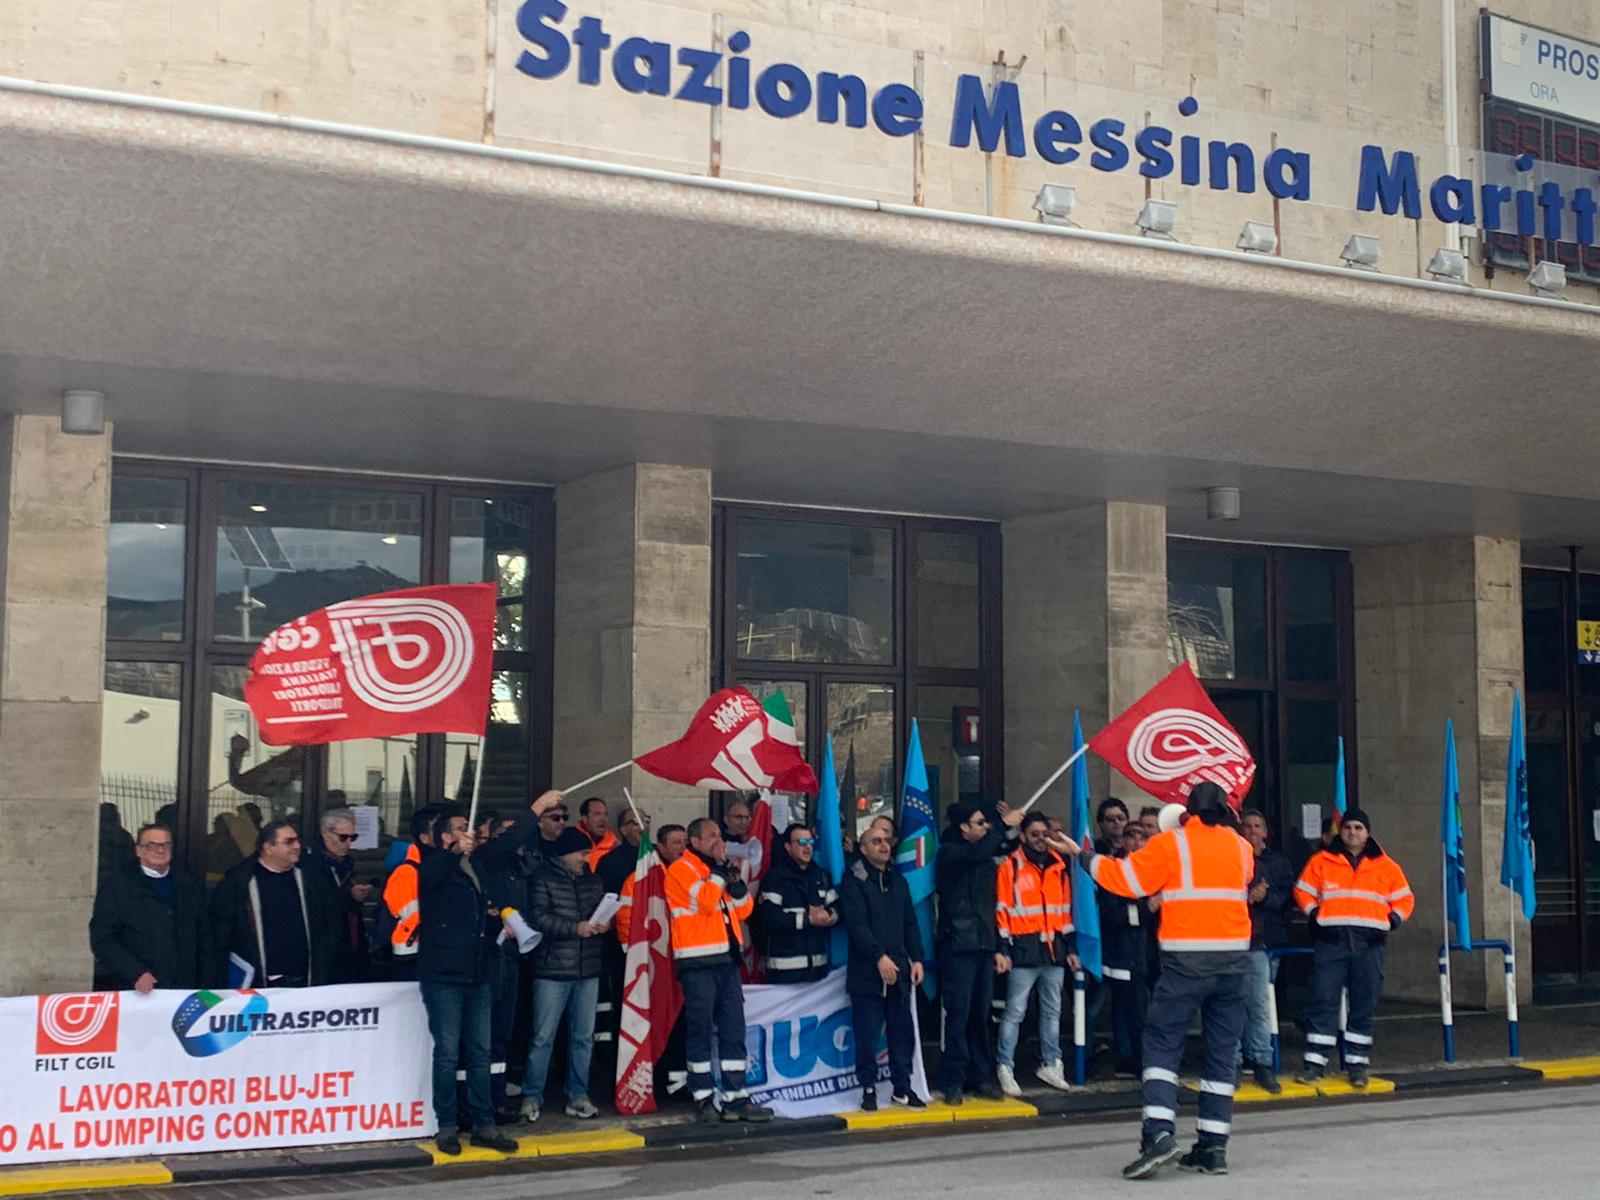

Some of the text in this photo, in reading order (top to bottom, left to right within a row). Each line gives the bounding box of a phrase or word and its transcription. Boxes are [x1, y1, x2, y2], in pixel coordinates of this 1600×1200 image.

[517, 0, 924, 137] Stazione
[951, 72, 1311, 202] Messina
[1529, 82, 1560, 104] ORA
[209, 1007, 380, 1034] UILTRASPORTI
[35, 1056, 116, 1072] FILT CGIL
[59, 1071, 355, 1114] LAVORATORI BLU-JET
[27, 1122, 64, 1152] AL
[73, 1116, 205, 1149] DUMPING
[214, 1101, 425, 1140] CONTRATTUALE
